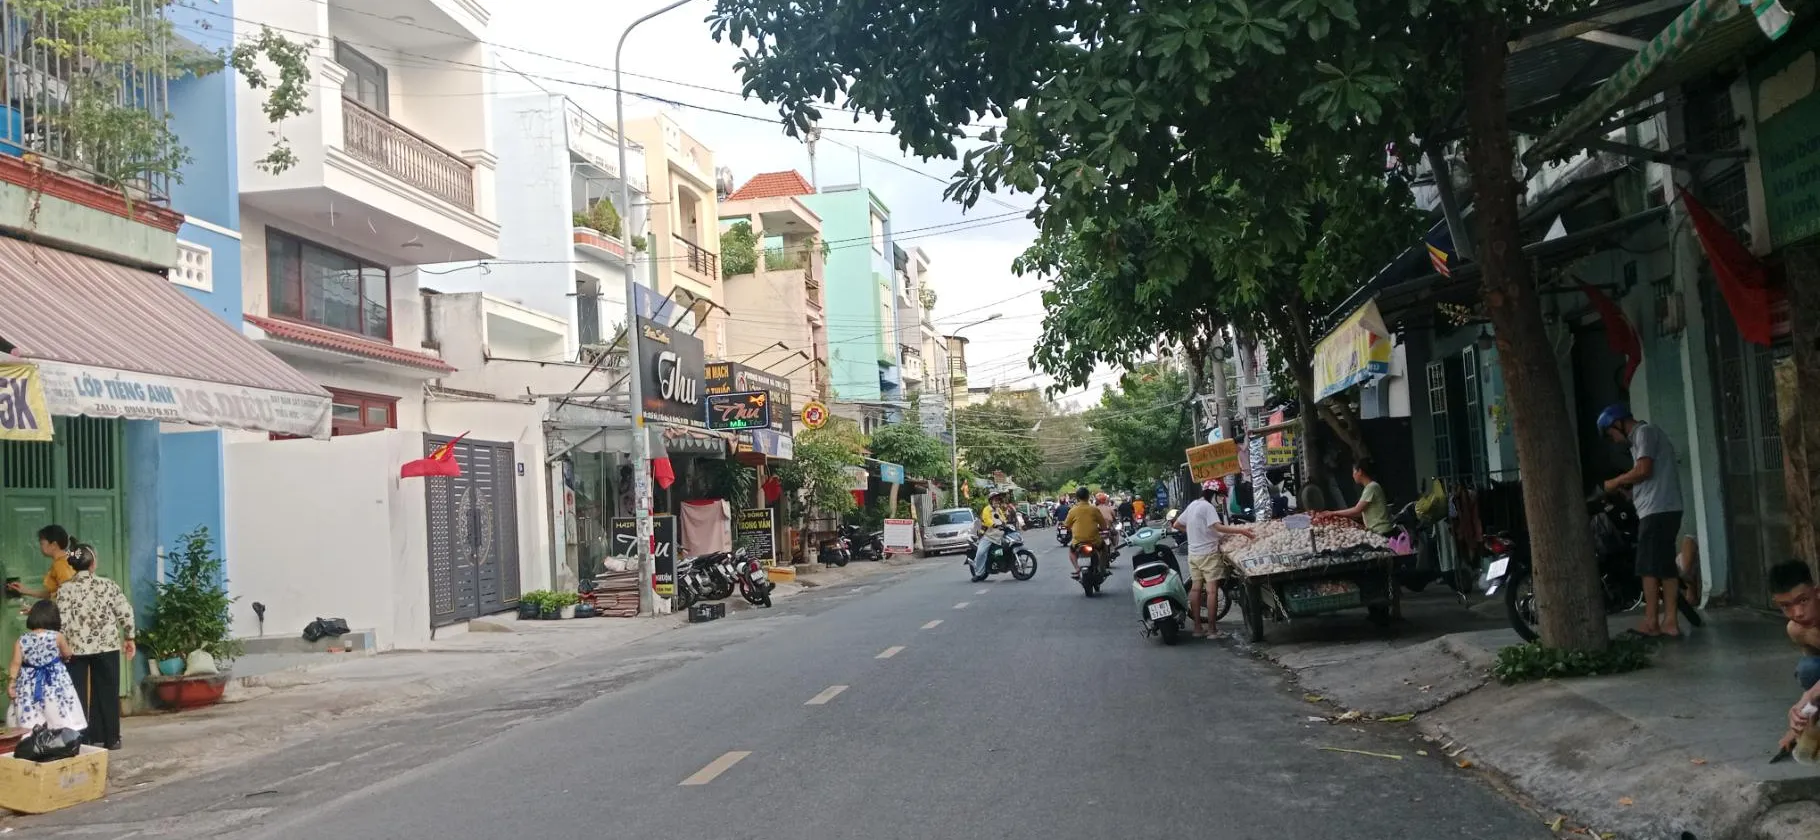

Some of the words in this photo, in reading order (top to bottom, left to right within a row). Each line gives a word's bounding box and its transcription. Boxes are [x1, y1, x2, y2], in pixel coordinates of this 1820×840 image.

[73, 371, 103, 397] LỚP
[104, 371, 146, 401] TIẾNG
[146, 384, 176, 404] ANH
[658, 351, 699, 405] Thu
[713, 402, 760, 422] Thu
[615, 521, 635, 529] HAIR
